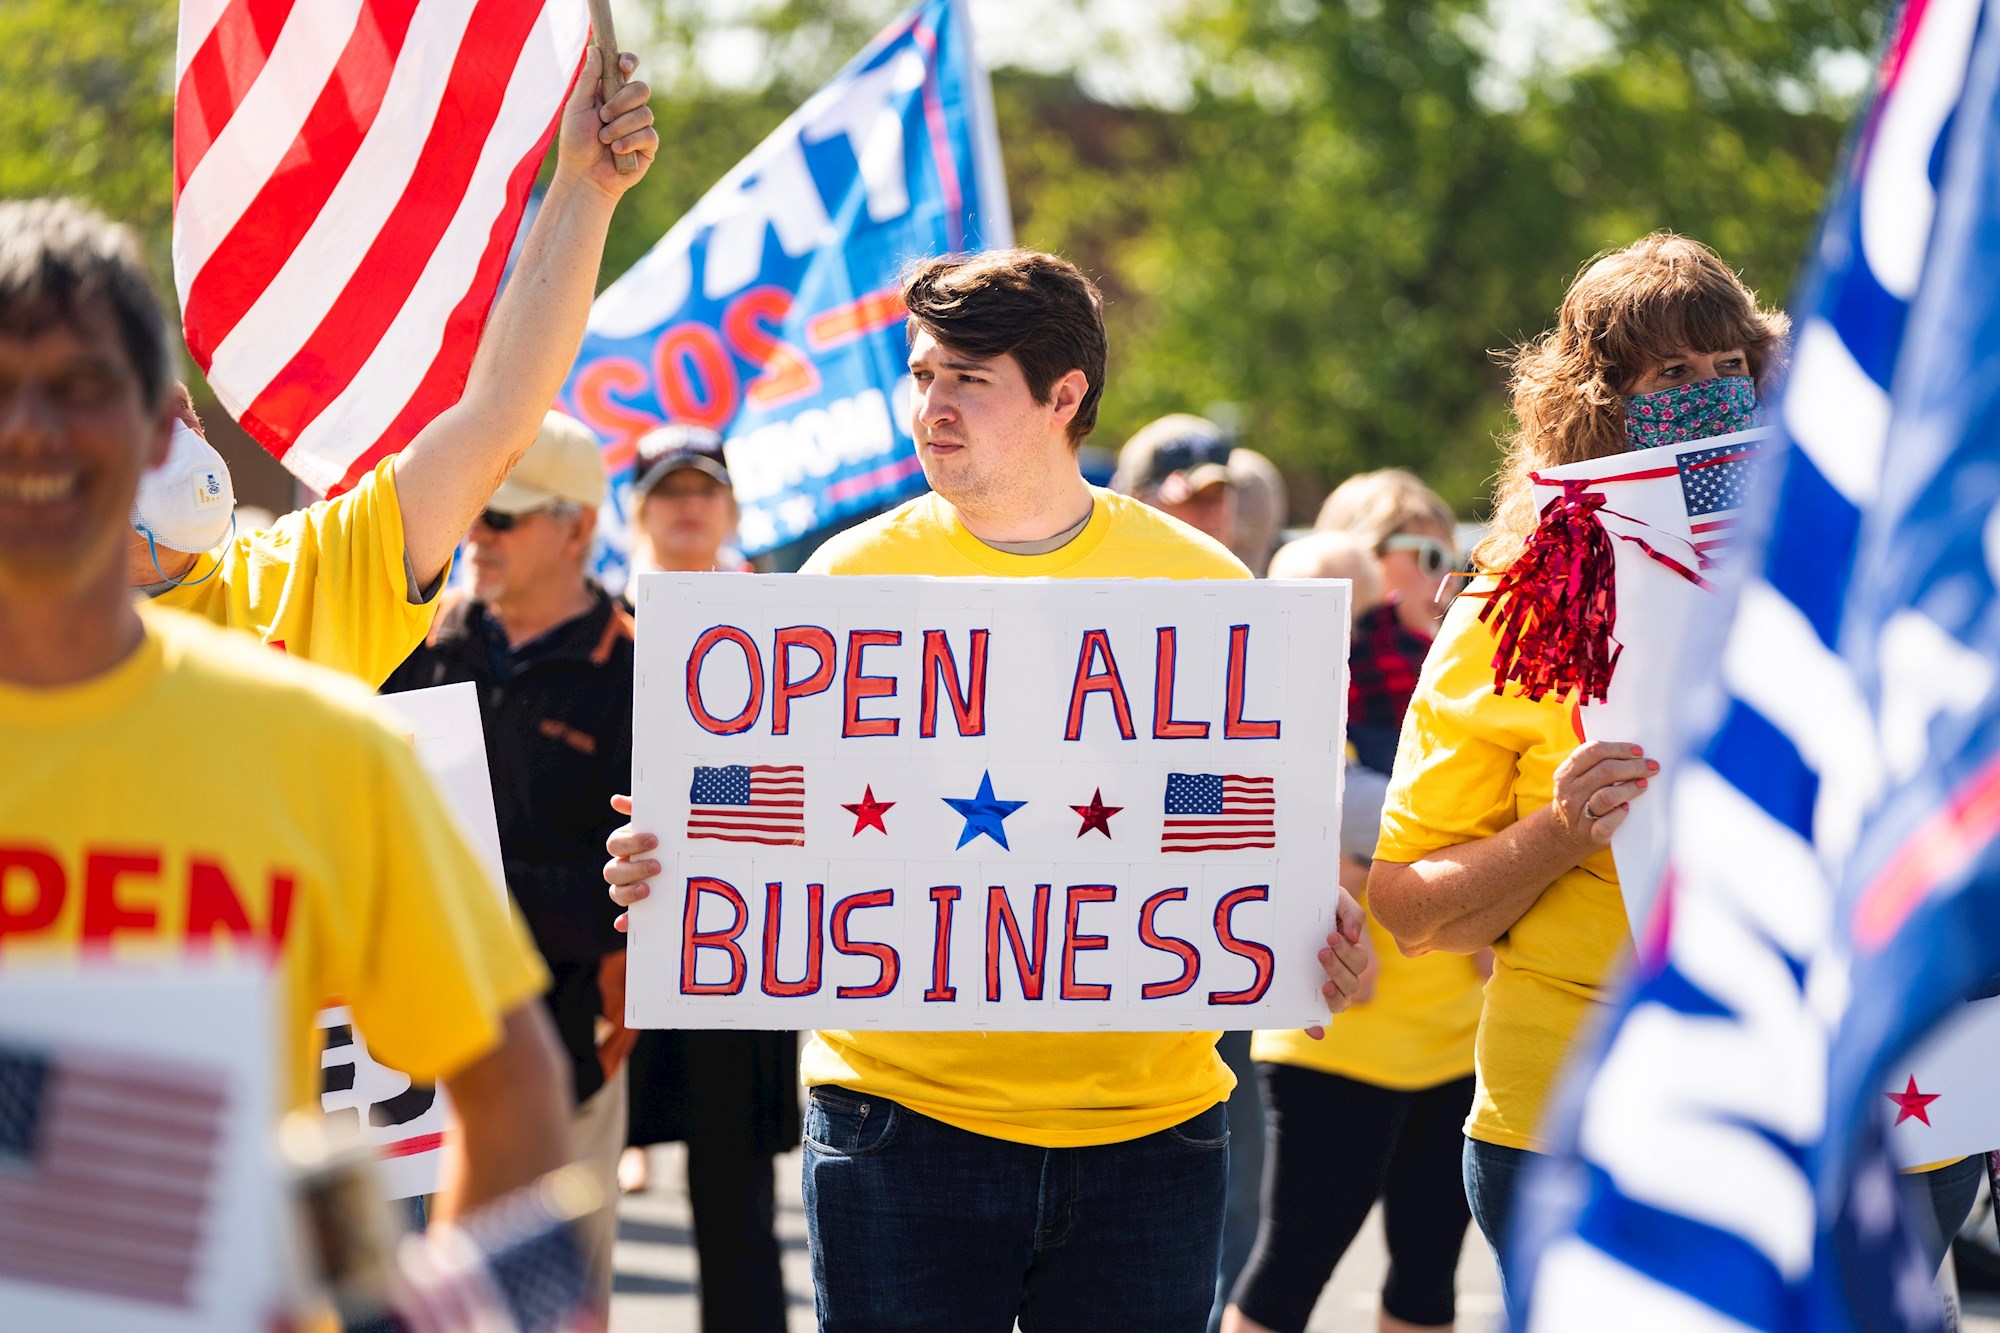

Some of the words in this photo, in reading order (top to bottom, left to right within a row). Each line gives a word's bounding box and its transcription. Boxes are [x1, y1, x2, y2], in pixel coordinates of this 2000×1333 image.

[686, 624, 990, 739] OPEN
[1063, 623, 1281, 742] ALL
[679, 875, 1275, 1006] BUSINESS
